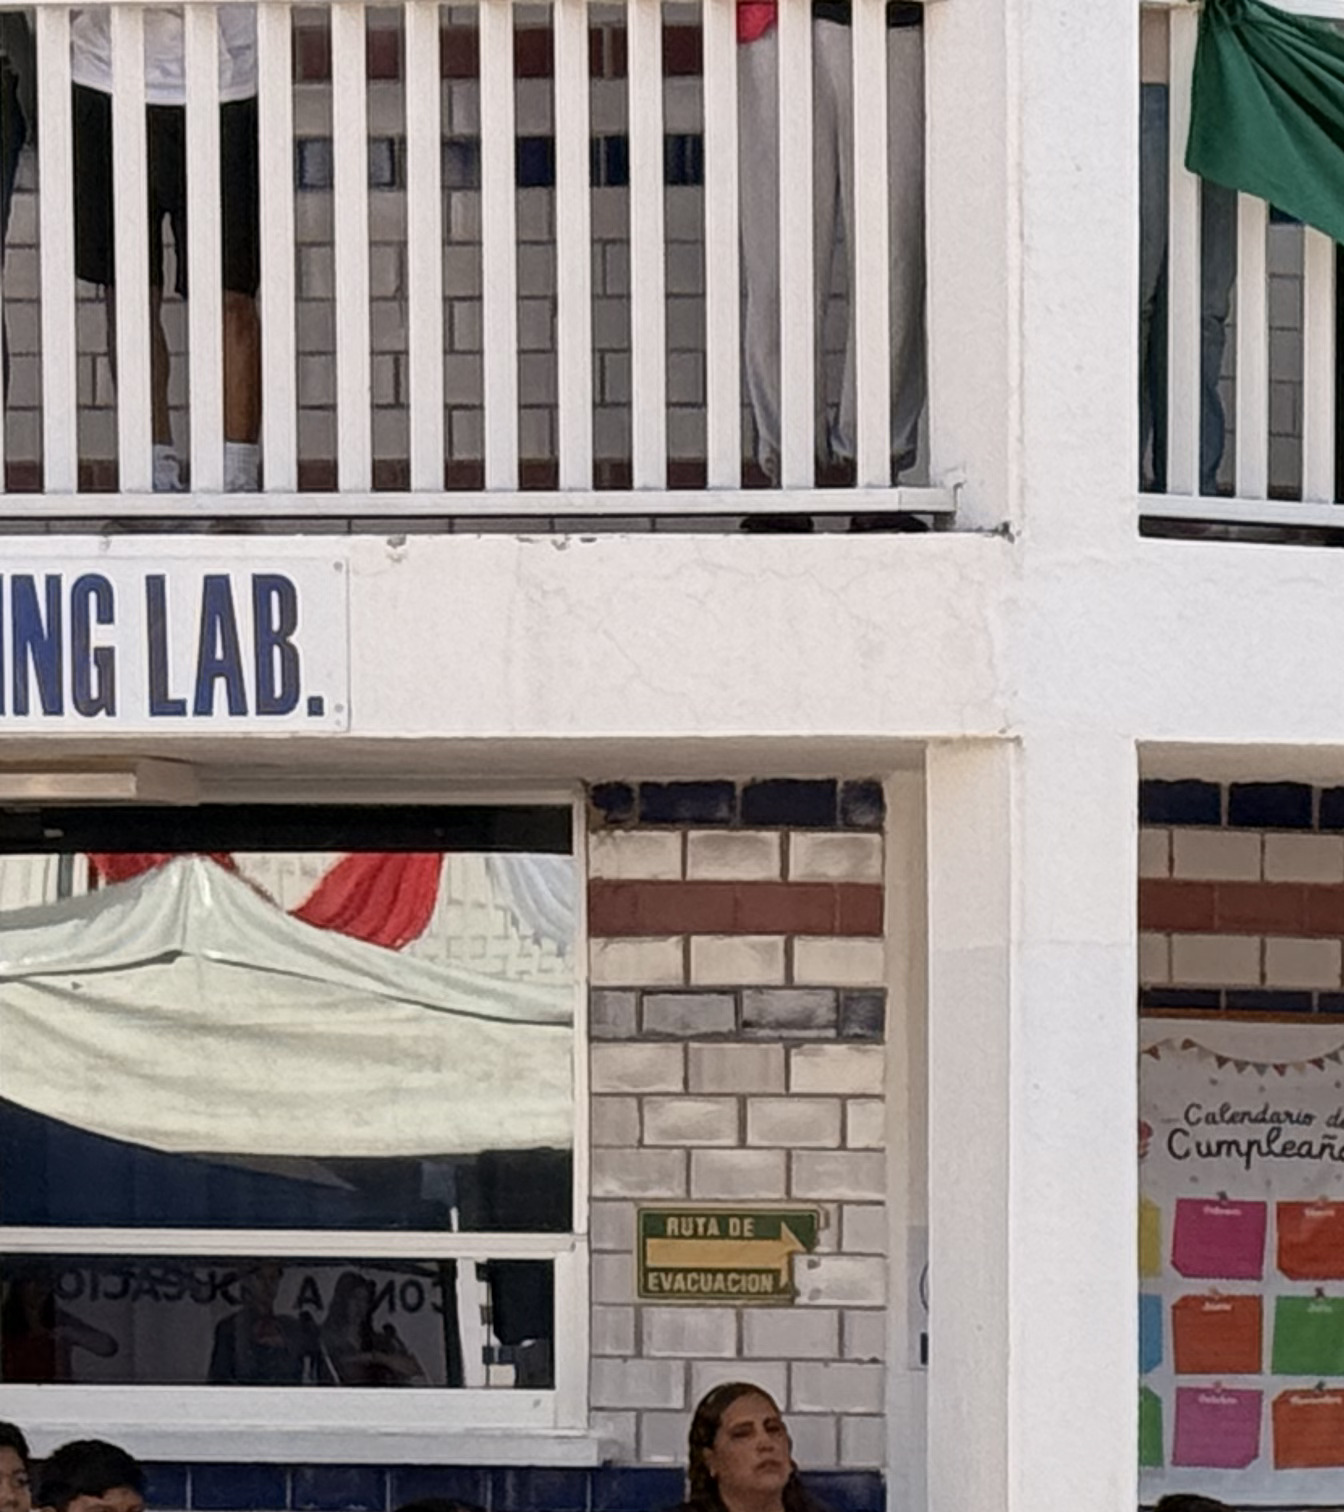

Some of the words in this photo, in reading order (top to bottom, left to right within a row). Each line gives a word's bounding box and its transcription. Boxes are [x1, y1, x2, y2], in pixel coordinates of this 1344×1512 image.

[0, 573, 117, 718] NG
[145, 573, 324, 717] LAB.
[1184, 1102, 1316, 1127] Calendario
[666, 1216, 720, 1237] RUTA
[728, 1217, 755, 1237] DE
[648, 1271, 774, 1293] EVACUACION
